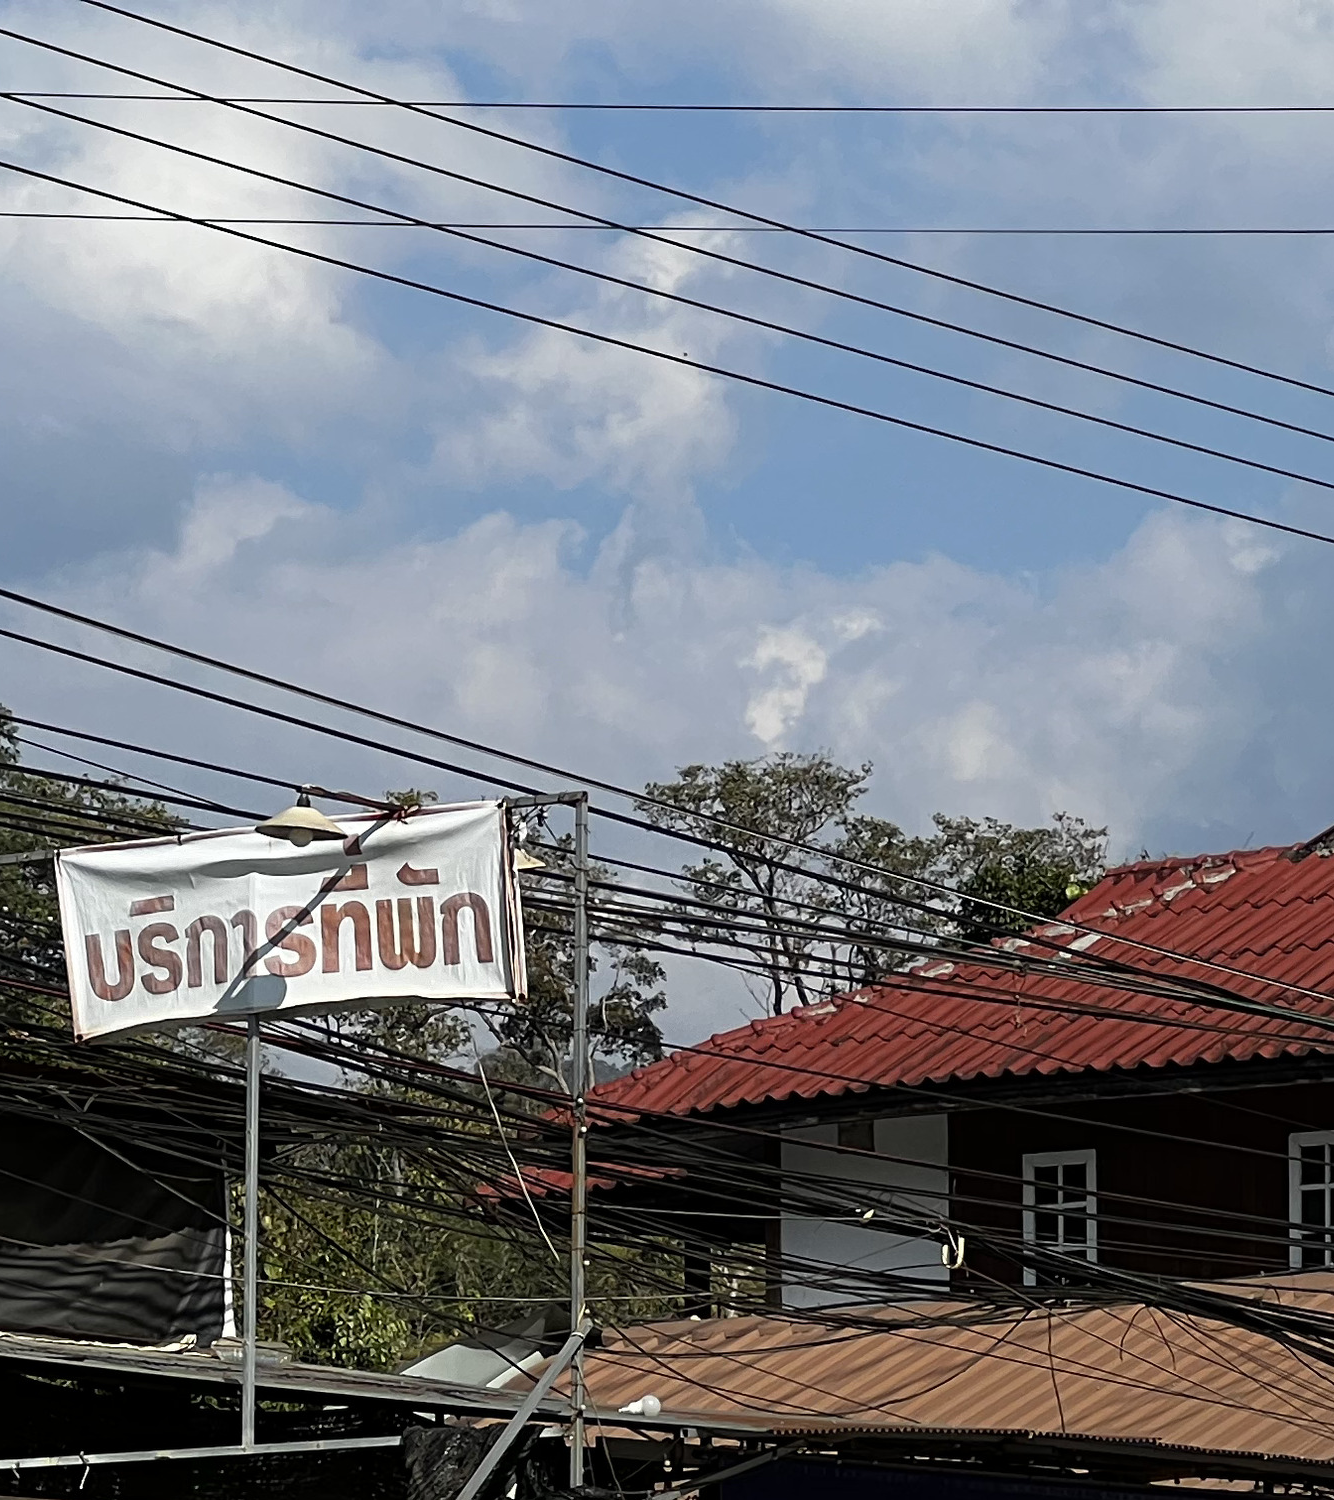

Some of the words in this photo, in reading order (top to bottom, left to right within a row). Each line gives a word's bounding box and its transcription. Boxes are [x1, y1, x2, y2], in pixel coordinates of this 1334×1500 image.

[85, 835, 494, 1001] บริการที่พัก
